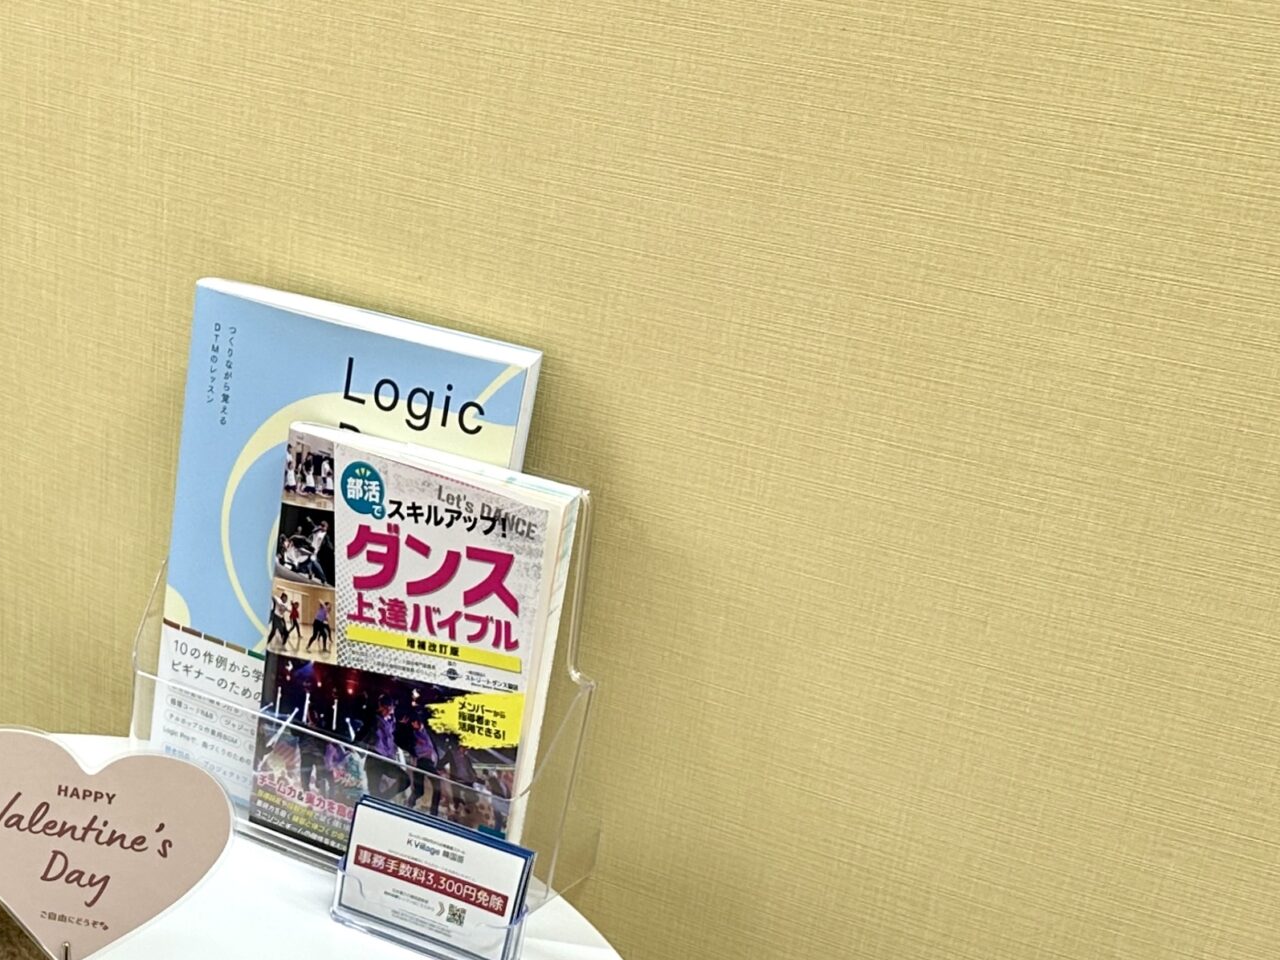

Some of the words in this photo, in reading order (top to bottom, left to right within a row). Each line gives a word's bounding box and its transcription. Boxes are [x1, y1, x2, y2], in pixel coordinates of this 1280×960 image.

[206, 322, 221, 404] DTMのレッスン
[220, 326, 237, 426] つくりながら覚える
[343, 357, 486, 435] Logic
[437, 485, 474, 514] Let's
[346, 523, 519, 618] ダンス
[347, 592, 520, 652] 上達バイブル
[406, 637, 460, 657] 増補改訂版
[458, 700, 506, 720] メンバーから
[458, 711, 498, 728] 指導者まで
[56, 783, 116, 806] HAPPY
[40, 849, 111, 907] Day
[357, 848, 505, 912] 事務手数料3,300円免除
[40, 910, 99, 929] ご自由にどうぞ
